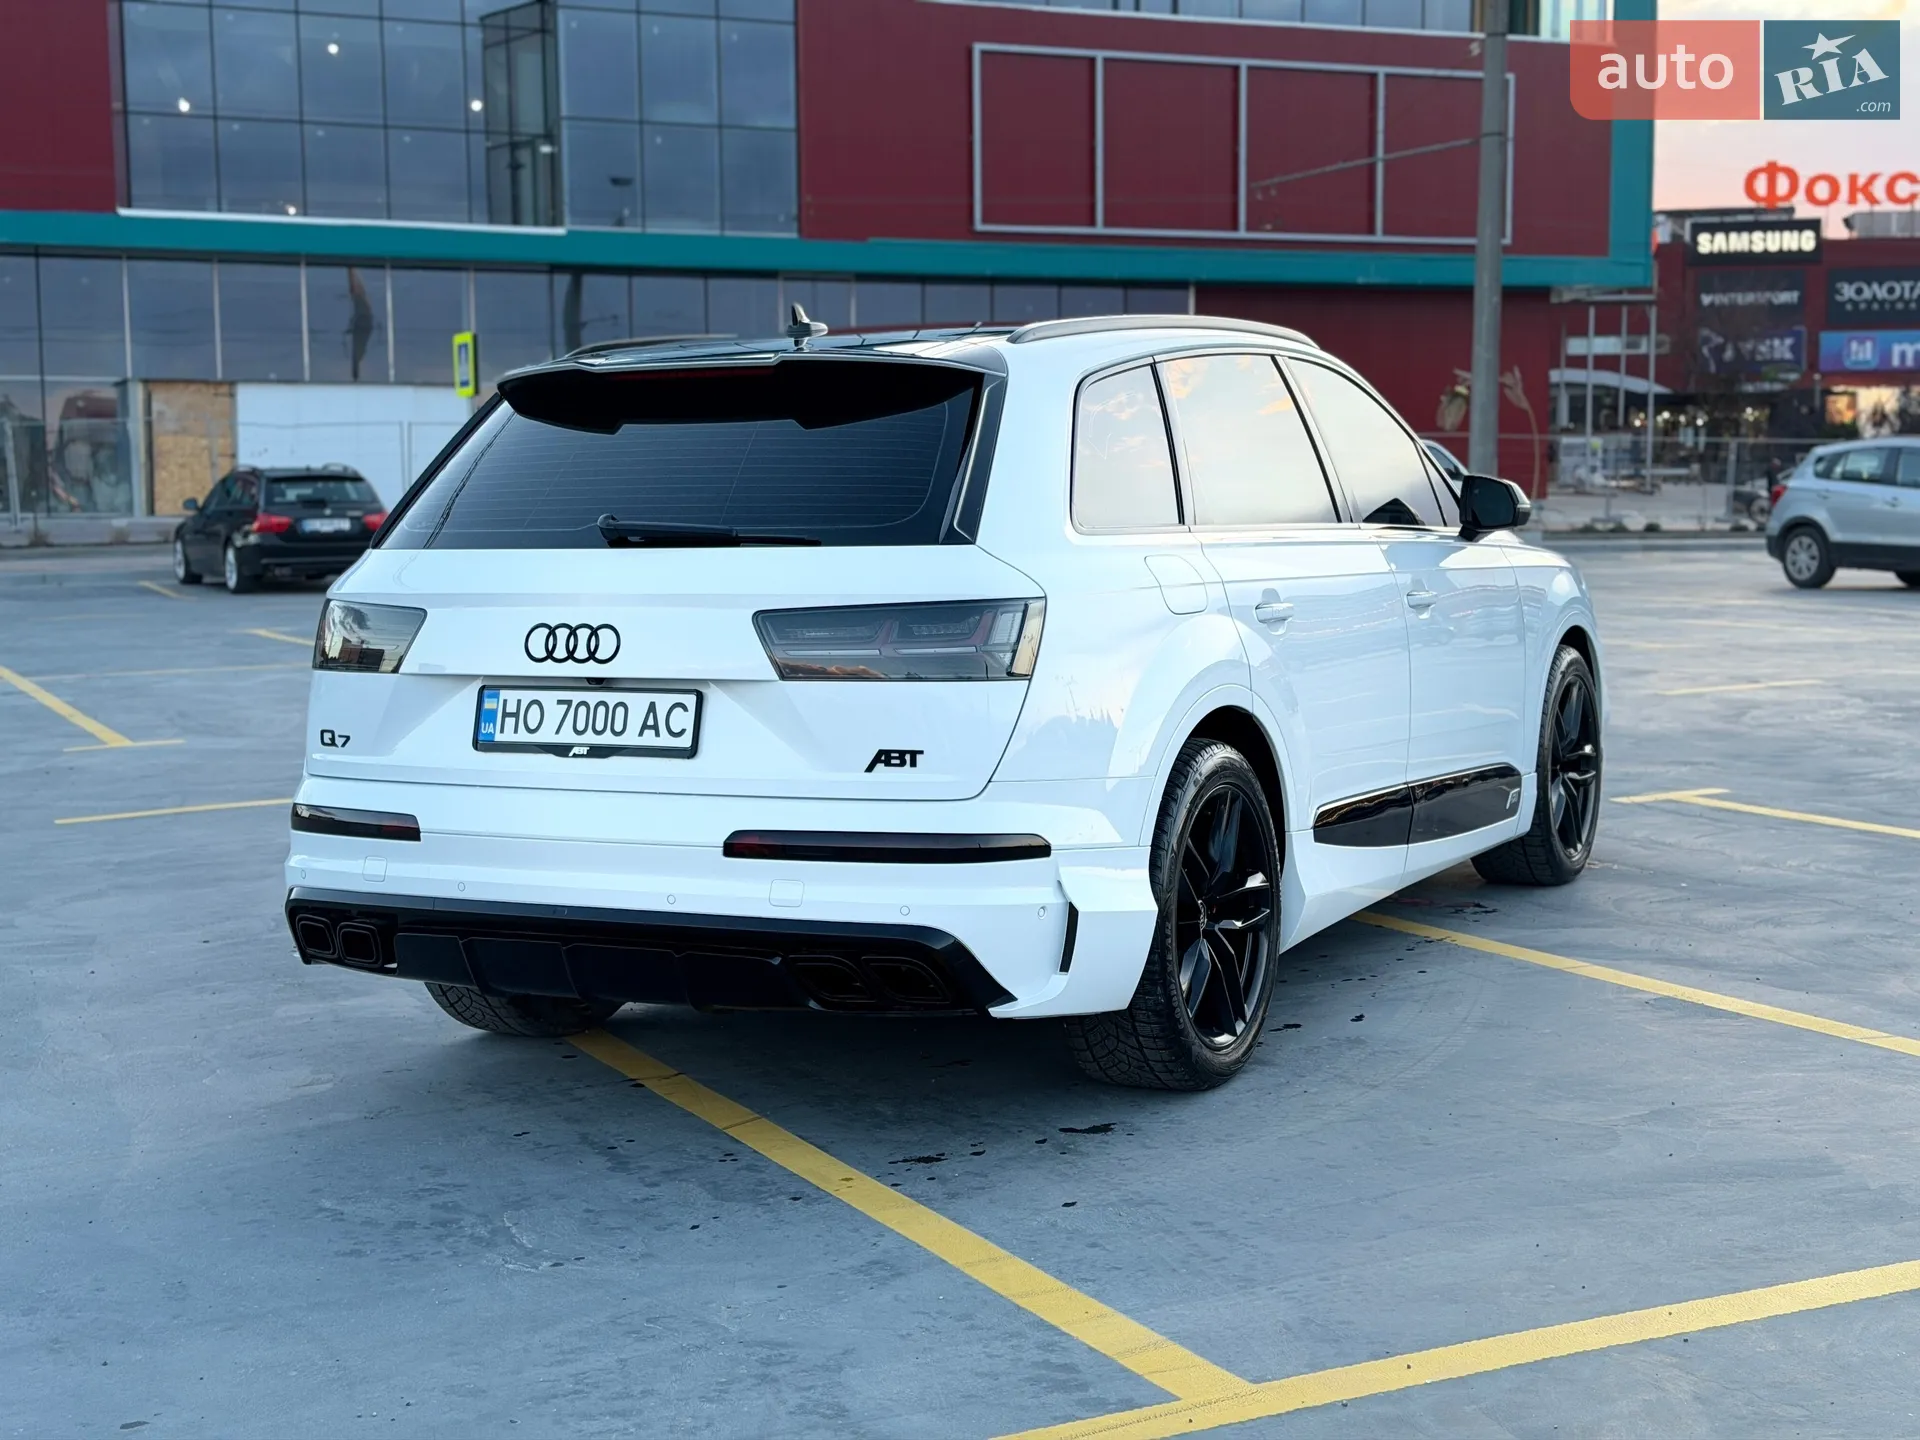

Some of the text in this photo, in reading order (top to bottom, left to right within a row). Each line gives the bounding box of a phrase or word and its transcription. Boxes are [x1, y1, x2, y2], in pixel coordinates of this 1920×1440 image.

[1744, 160, 1920, 209] Фокс
[1697, 230, 1817, 254] SAMSUNG
[481, 722, 495, 734] UA
[499, 698, 690, 738] HO 7000 AC
[320, 729, 351, 748] Q7
[568, 746, 590, 757] ABT
[864, 749, 924, 773] ABT
